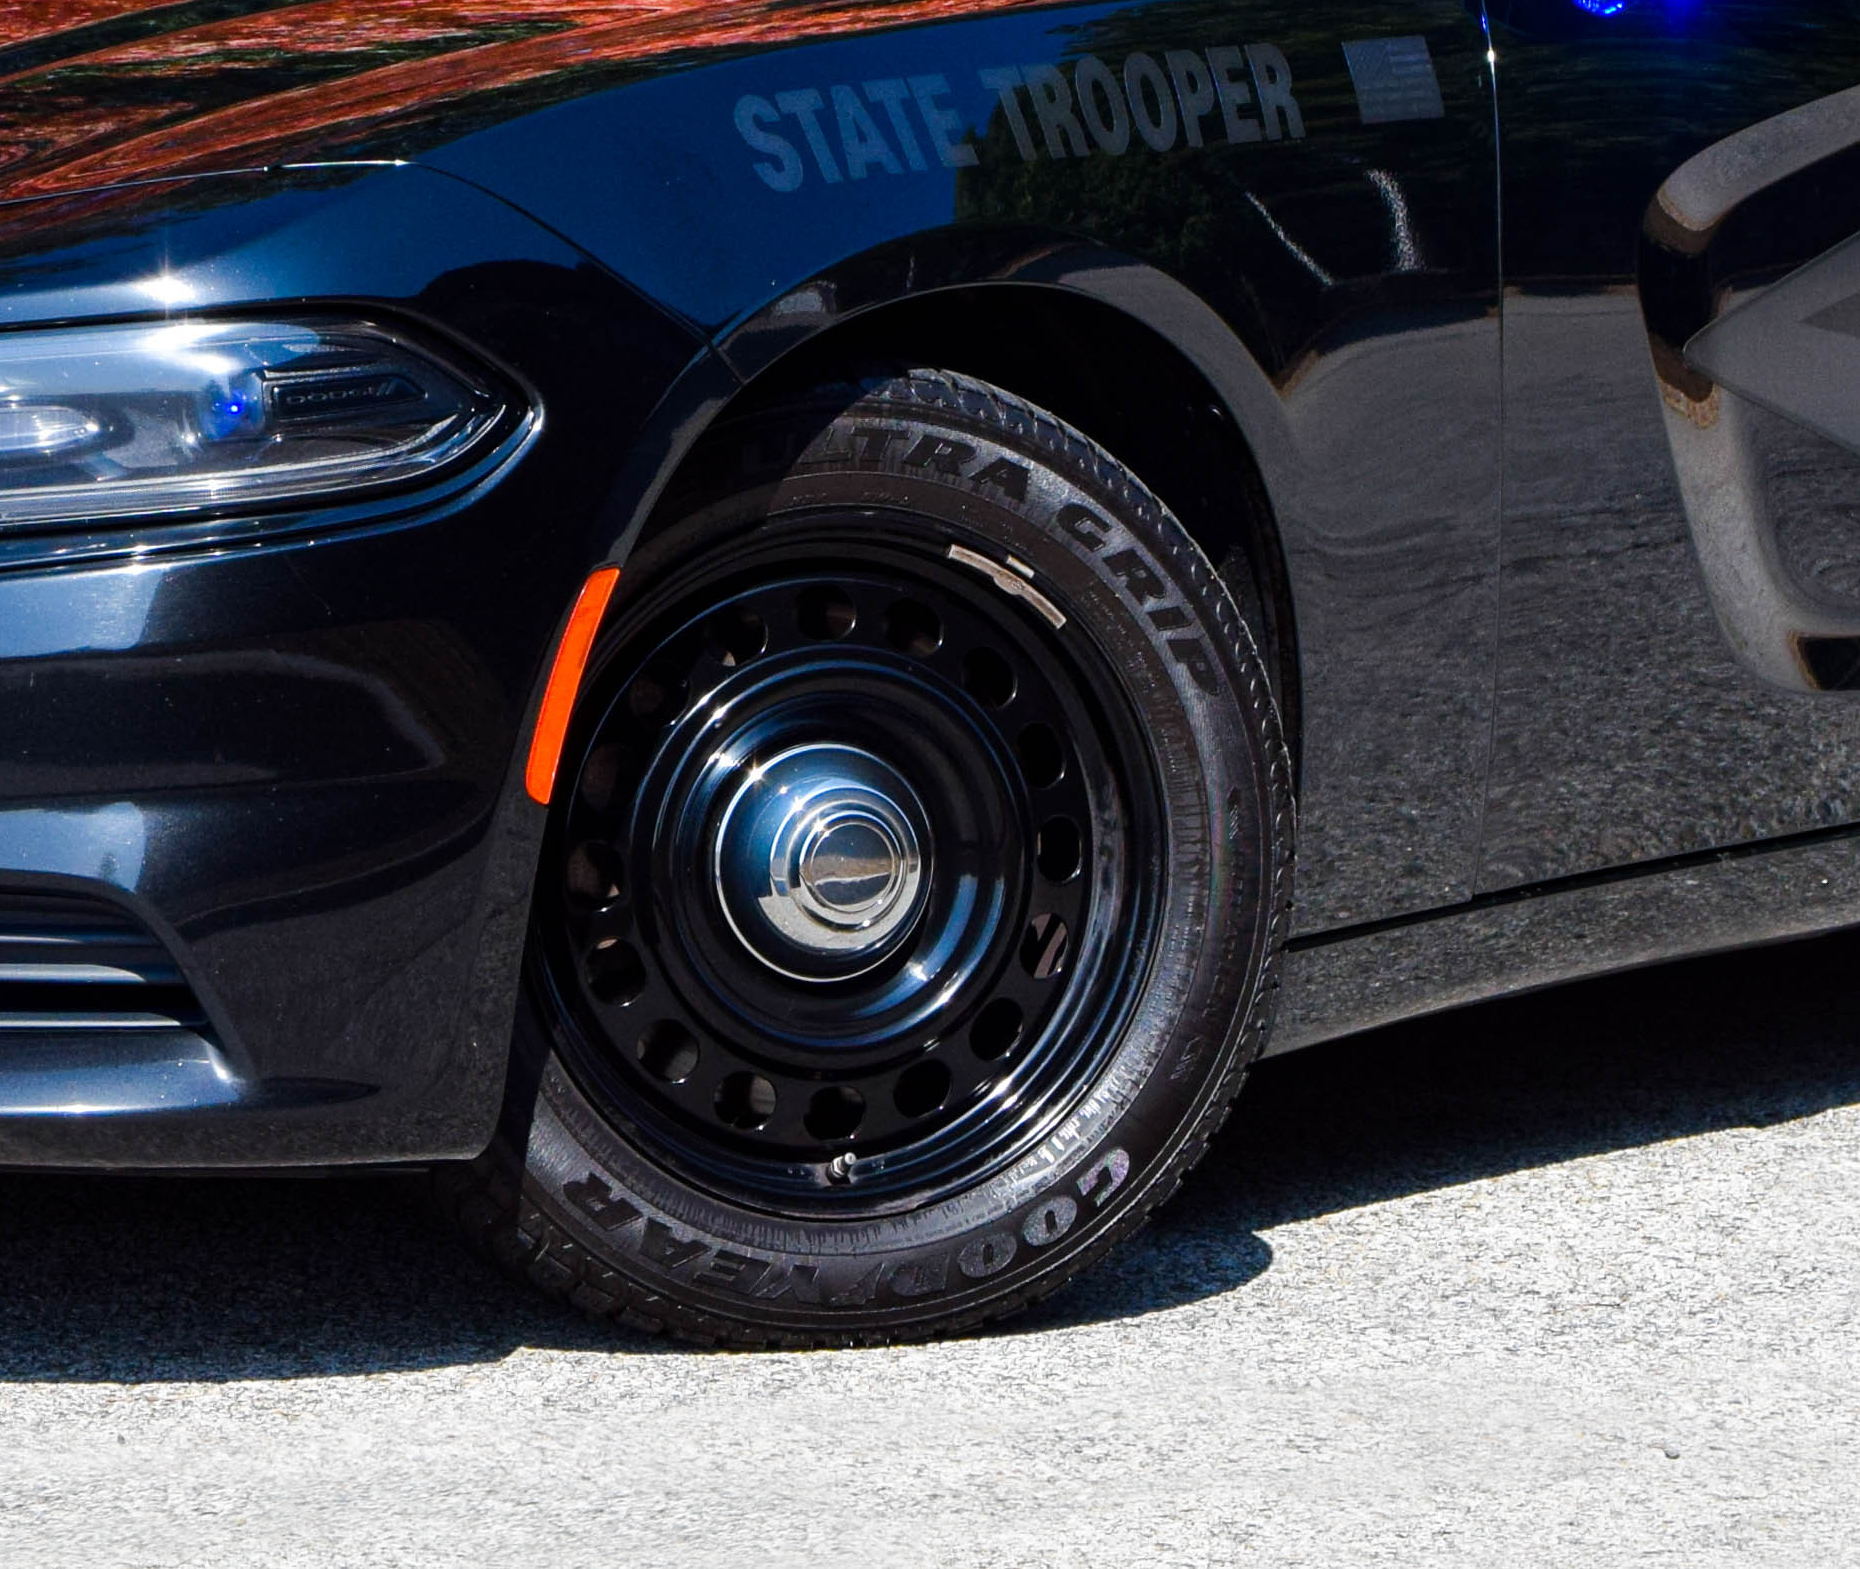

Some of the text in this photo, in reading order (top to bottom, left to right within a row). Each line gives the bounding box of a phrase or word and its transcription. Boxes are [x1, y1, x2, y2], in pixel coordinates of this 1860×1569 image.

[734, 42, 1306, 193] STATE TROOPER
[1053, 501, 1224, 698] GRIP
